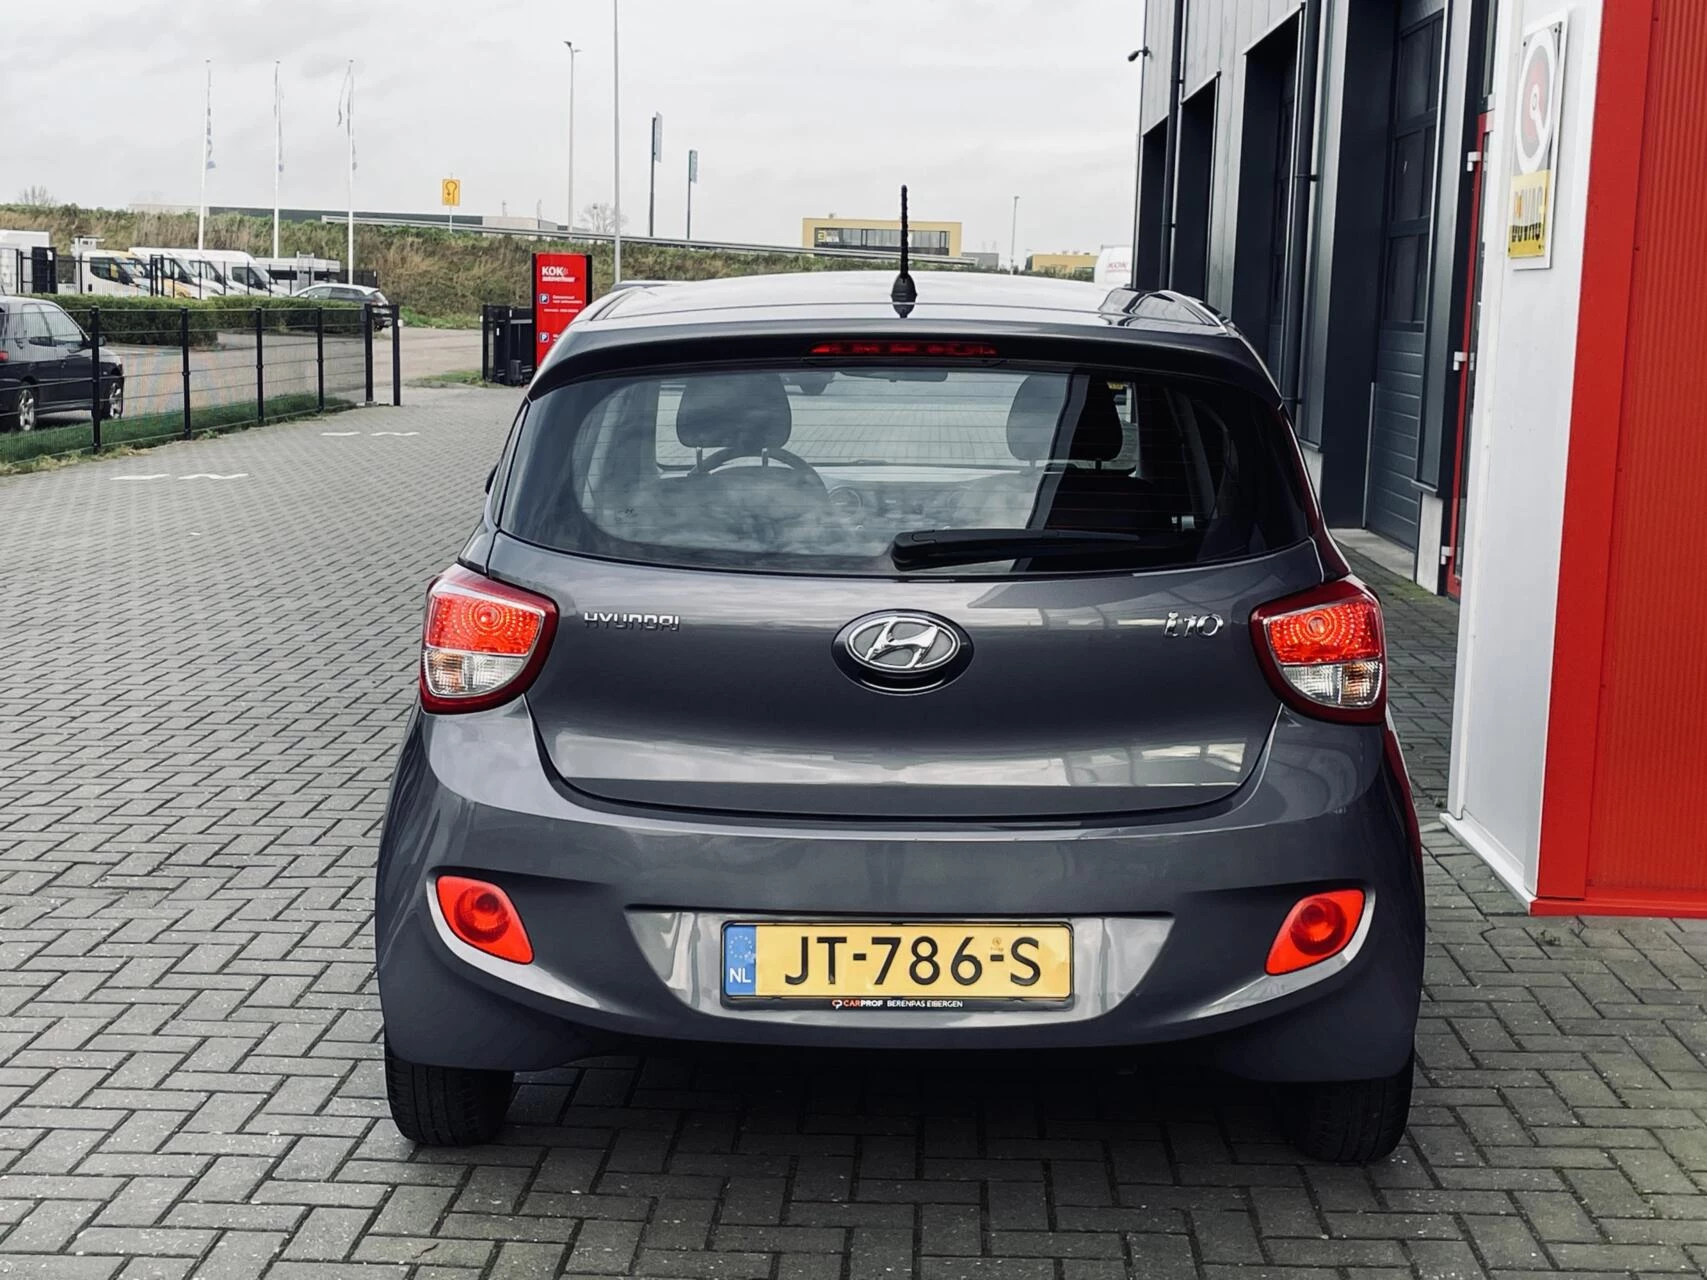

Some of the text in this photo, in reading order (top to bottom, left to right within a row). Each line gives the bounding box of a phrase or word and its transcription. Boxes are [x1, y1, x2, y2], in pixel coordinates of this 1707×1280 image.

[541, 266, 564, 276] KOK
[584, 612, 679, 631] HYUNDAI
[785, 936, 1041, 986] JT-786-S
[729, 968, 751, 983] NL
